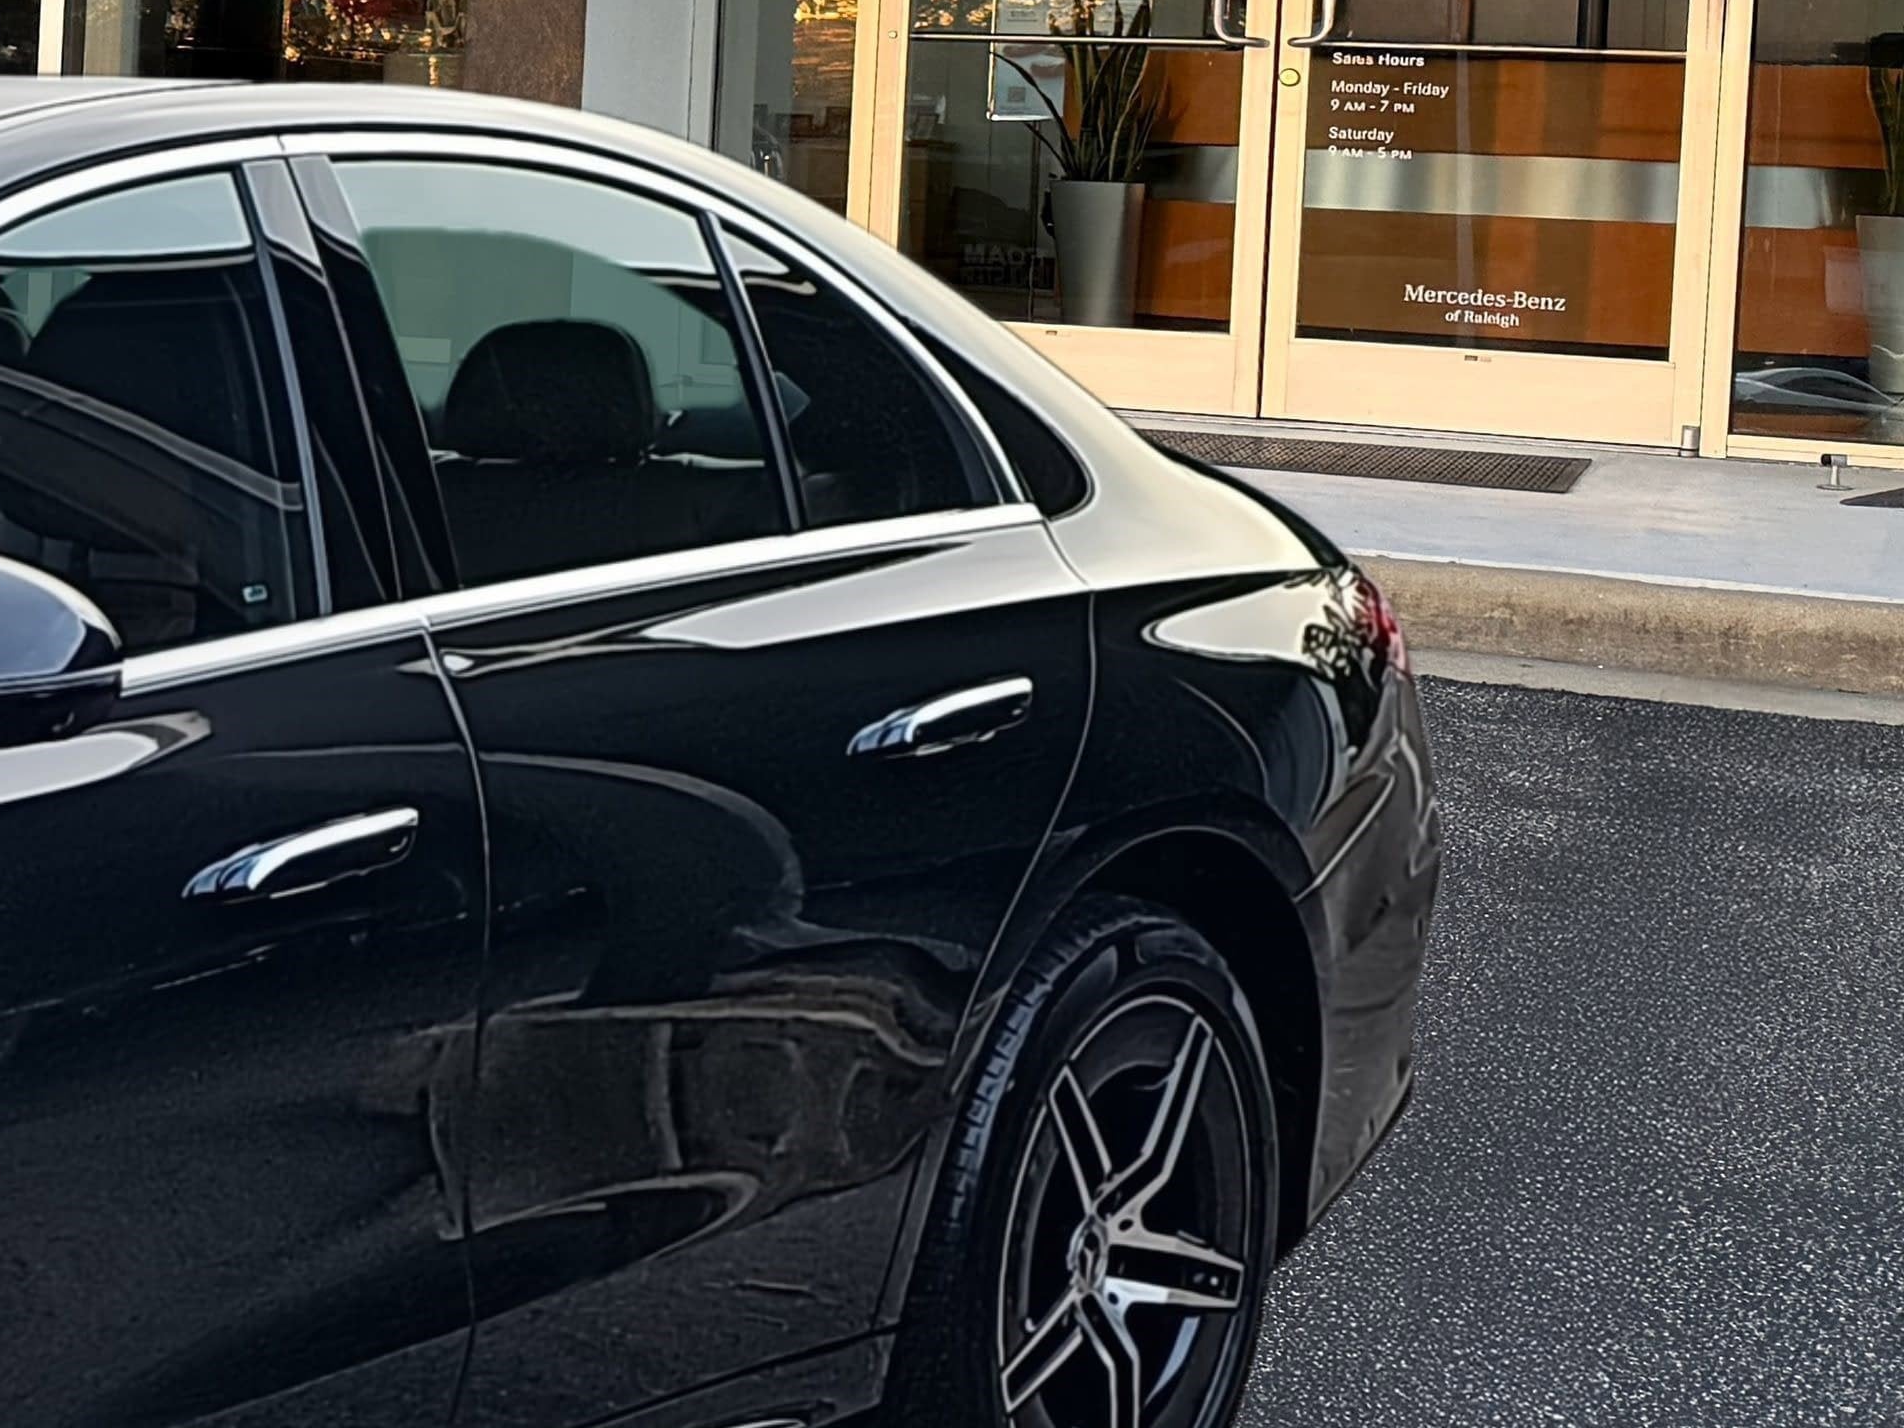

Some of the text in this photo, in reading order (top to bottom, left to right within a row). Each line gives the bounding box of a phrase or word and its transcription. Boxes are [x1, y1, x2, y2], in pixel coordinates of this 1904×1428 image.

[1378, 52, 1425, 67] Hours
[1331, 79, 1390, 97] Monday
[1403, 82, 1450, 99] Friday
[1330, 98, 1340, 112] 9
[1344, 102, 1366, 112] AM
[1380, 100, 1390, 113] 7
[1393, 103, 1415, 113] PM
[1328, 126, 1394, 144] Saturday
[1342, 149, 1364, 159] AM
[1377, 146, 1387, 160] 5
[1391, 150, 1413, 160] PM
[1403, 283, 1567, 312] Mercedes-Benz
[1445, 308, 1521, 329] of Raleigh
